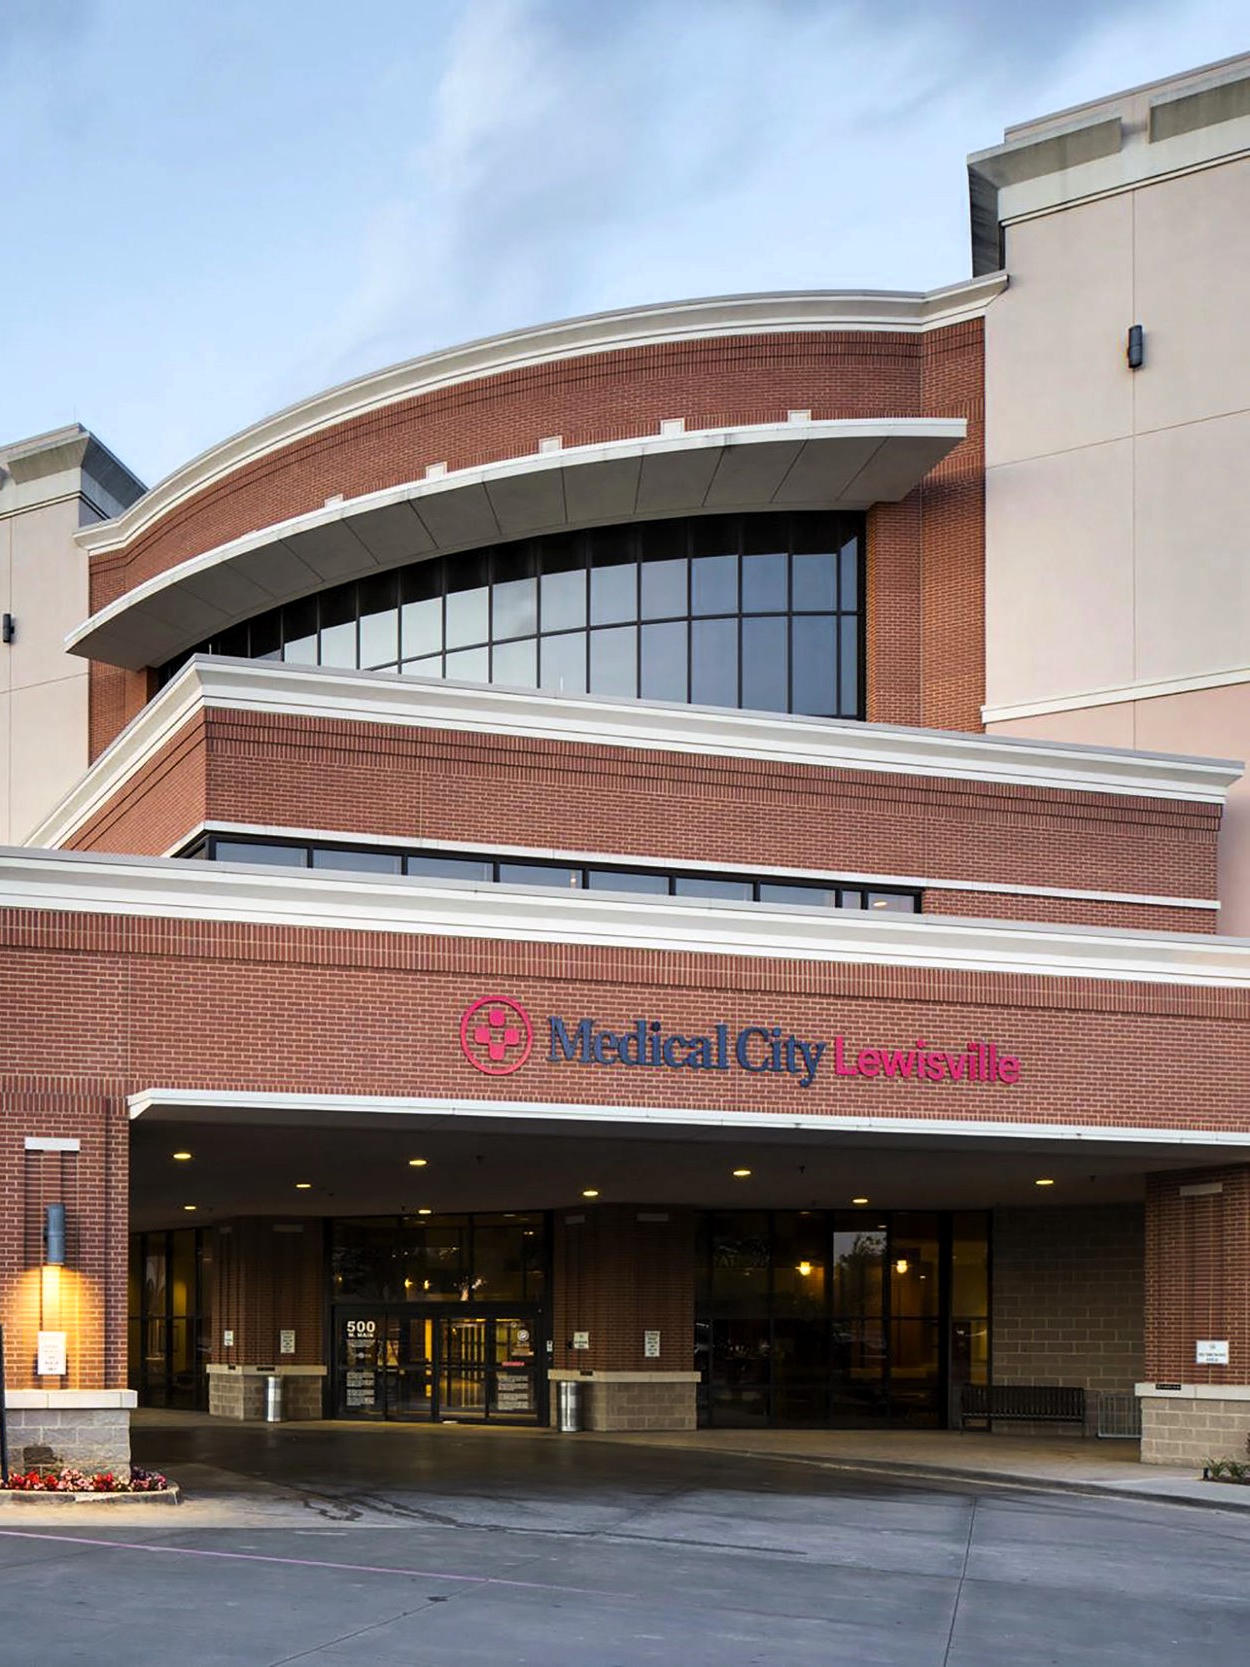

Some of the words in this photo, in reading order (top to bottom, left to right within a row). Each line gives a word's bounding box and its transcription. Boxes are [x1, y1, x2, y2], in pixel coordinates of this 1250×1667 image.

[546, 1015, 730, 1070] Medical
[736, 1027, 826, 1087] City
[834, 1036, 1021, 1084] Lewisville
[347, 1321, 376, 1333] 500
